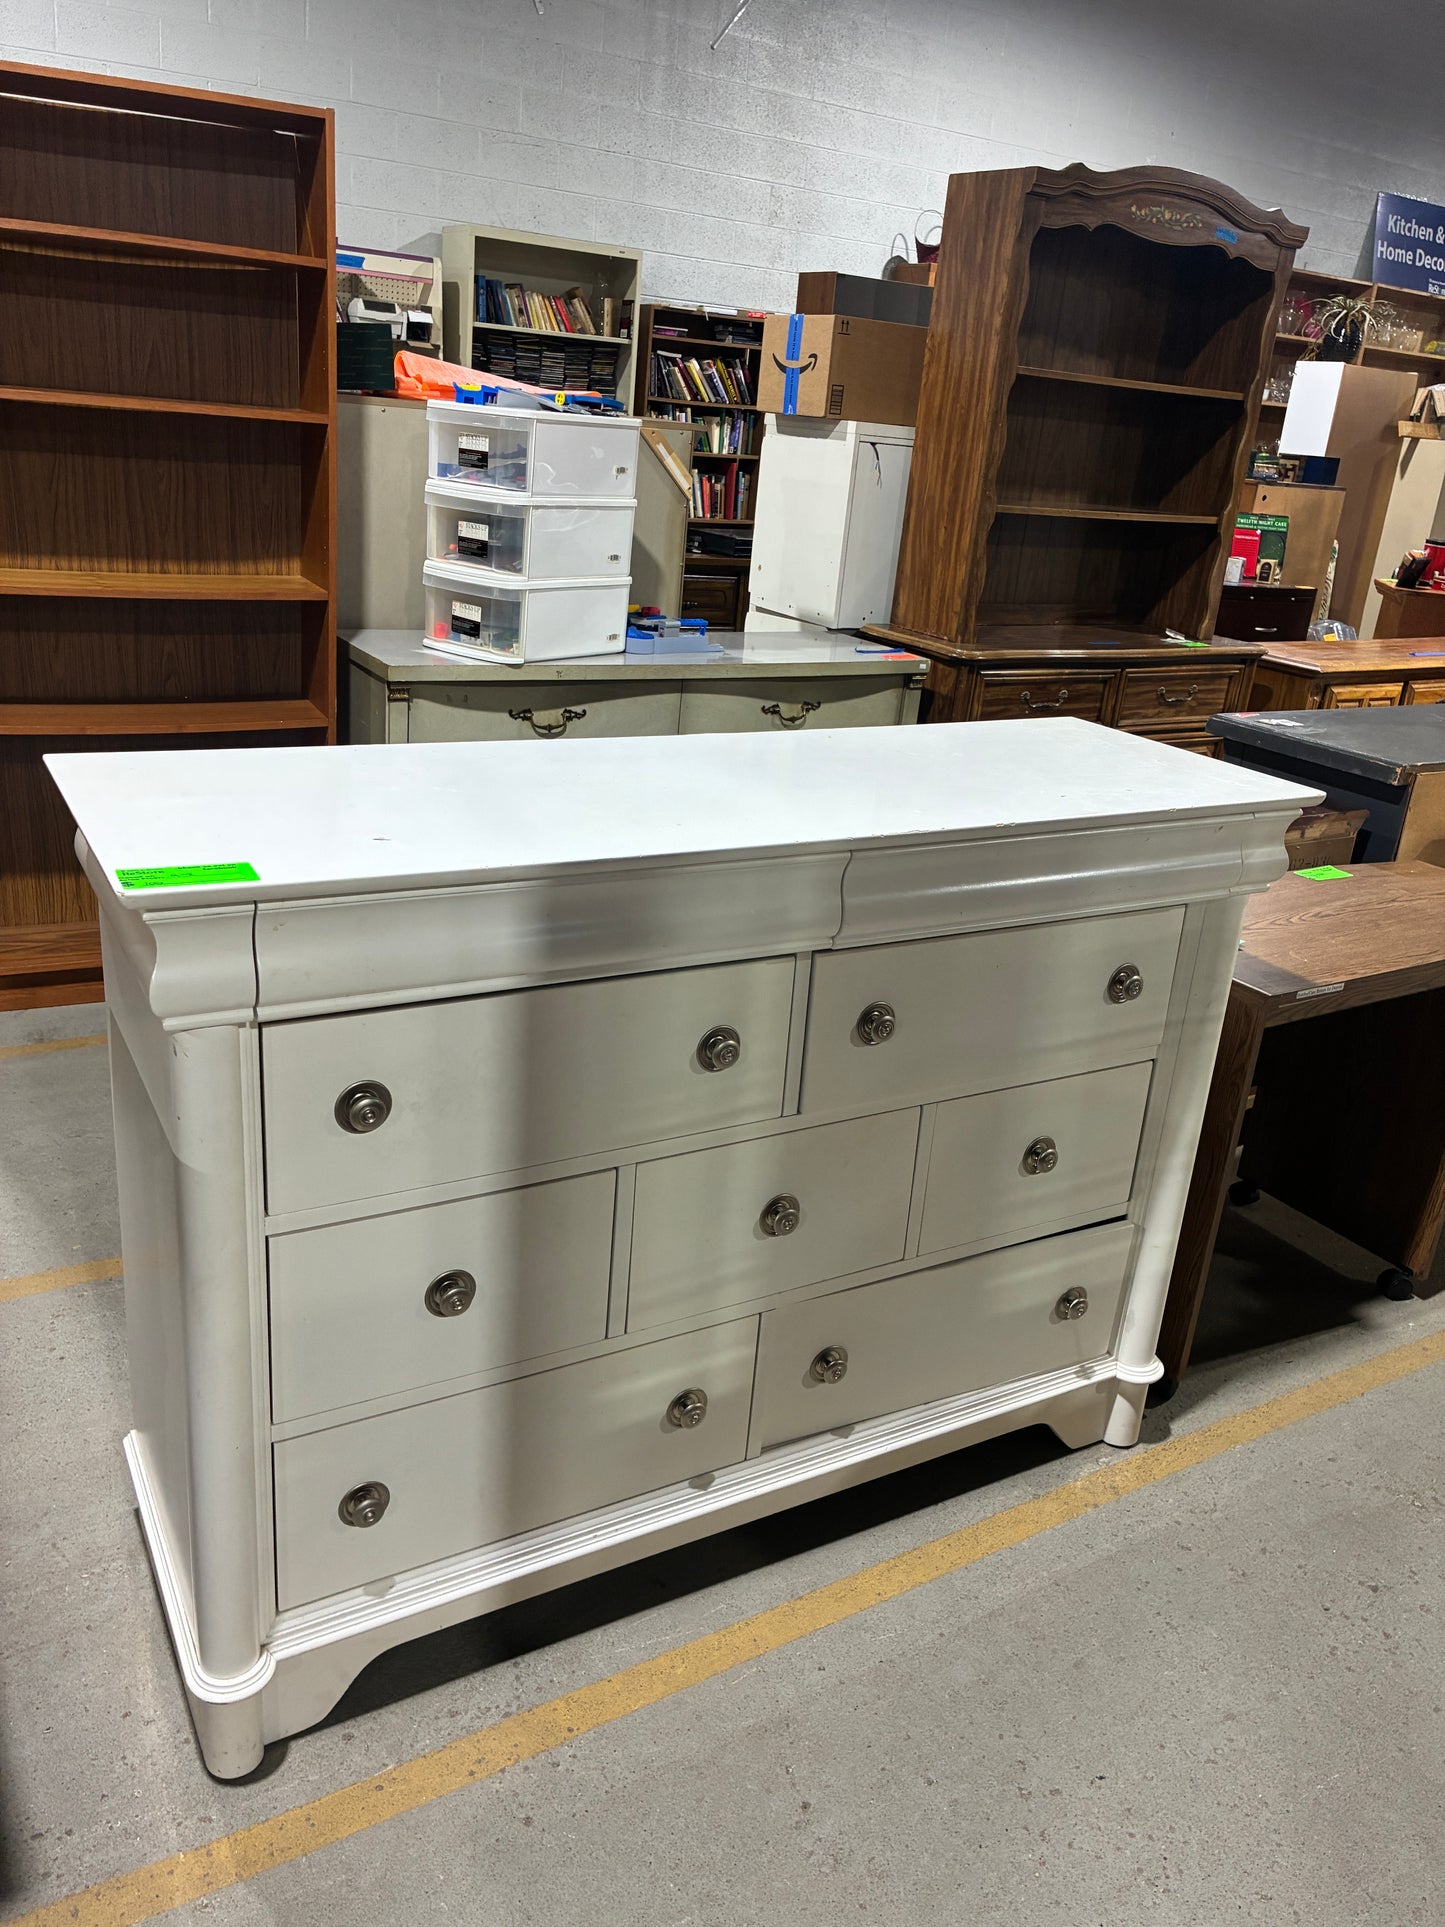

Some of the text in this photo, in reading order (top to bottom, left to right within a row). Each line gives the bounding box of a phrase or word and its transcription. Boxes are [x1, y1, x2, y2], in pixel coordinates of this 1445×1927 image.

[1387, 213, 1445, 245] Kitchen &
[1377, 239, 1445, 273] Home Deco
